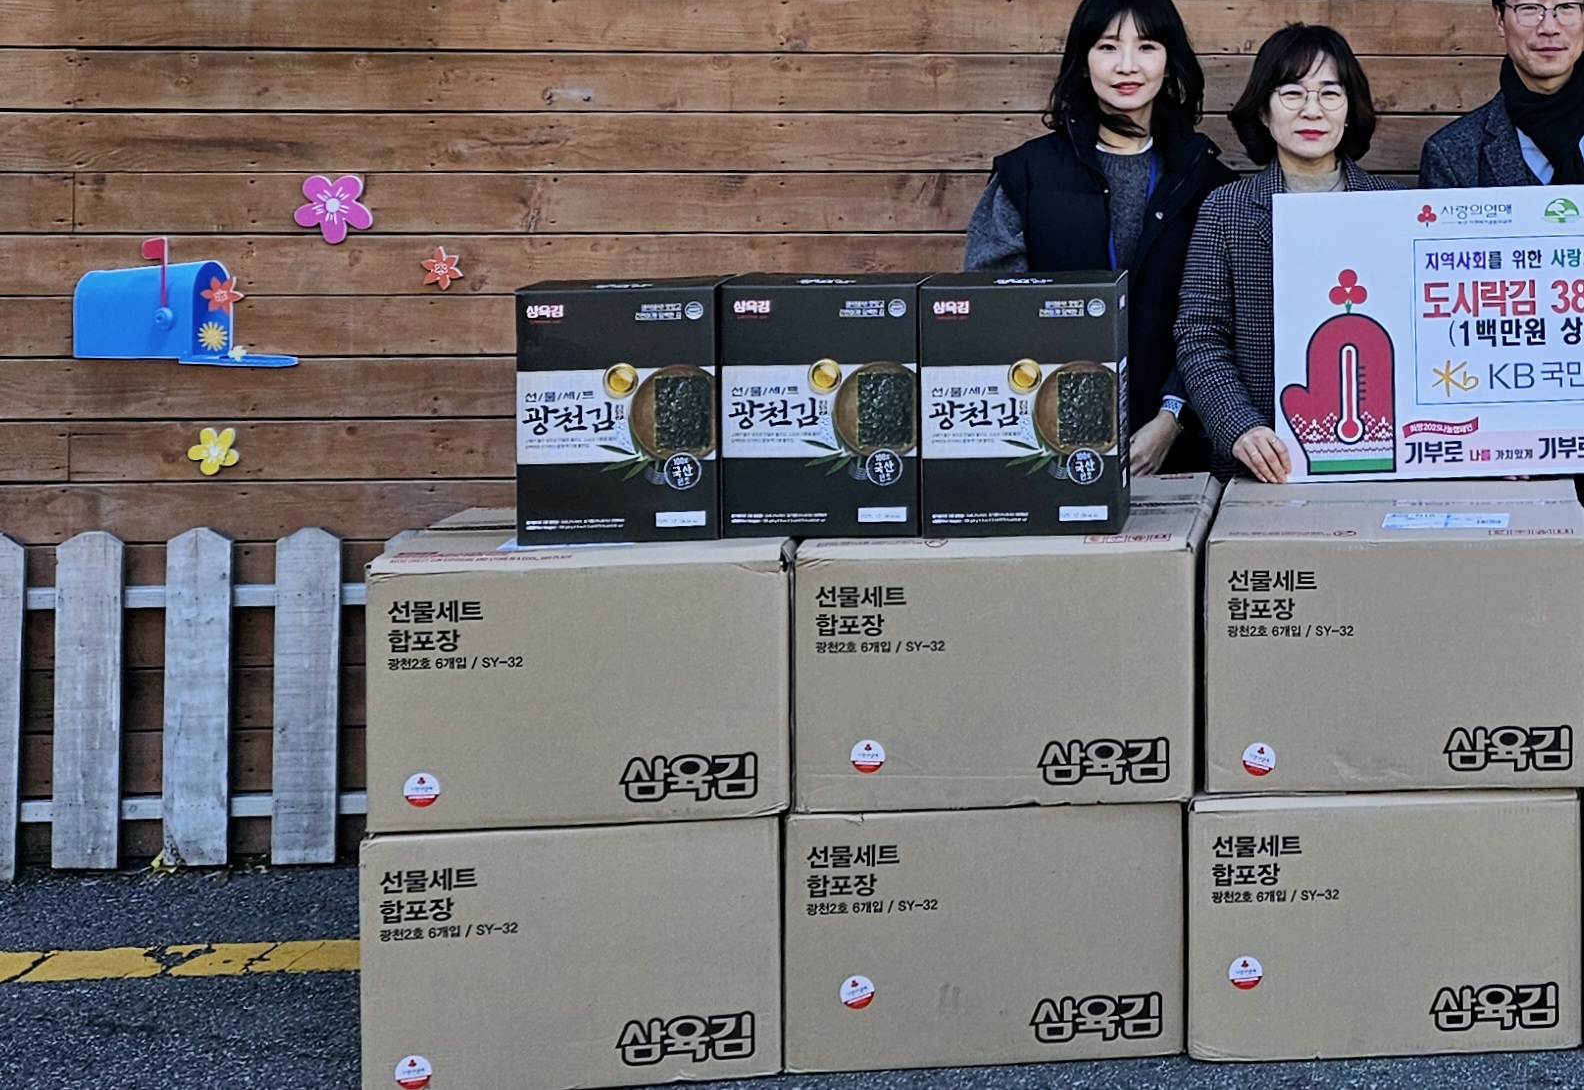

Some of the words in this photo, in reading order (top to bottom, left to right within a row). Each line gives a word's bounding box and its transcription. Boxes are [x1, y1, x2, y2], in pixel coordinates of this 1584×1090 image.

[1425, 251, 1502, 271] 지역사회를
[1512, 249, 1542, 269] 위한
[733, 299, 771, 314] 삼육김
[932, 299, 970, 315] 삼육김
[1423, 279, 1536, 318] 도시락김
[526, 304, 565, 319] 삼육김
[522, 401, 617, 434] 광천김
[728, 396, 819, 429] 광천김
[928, 397, 1020, 429] 광천김
[1405, 440, 1464, 464] 기부로
[1470, 449, 1491, 462] 나를
[1495, 449, 1533, 461] 가치있게
[1228, 570, 1317, 592] 선물세트
[816, 586, 906, 608] 선물세트
[388, 600, 483, 623] 선물세트
[1228, 598, 1295, 620] 합포장
[816, 614, 884, 636] 합포장
[1228, 625, 1268, 637] 광천2호
[1272, 625, 1301, 637] 6개입
[1316, 626, 1353, 636] SY-32
[388, 629, 460, 652] 합포장
[816, 642, 856, 653] 광천2호
[861, 641, 891, 652] 6개입
[906, 641, 945, 652] SY-32
[388, 658, 431, 670] 광천2호
[436, 657, 466, 669] 6개입
[482, 657, 523, 668] SY-32
[1443, 725, 1573, 772] 삼육김
[1037, 737, 1170, 785] 삼육김
[619, 752, 758, 802] 삼육김
[807, 844, 900, 868] 선물세트
[1212, 835, 1302, 858] 선물세트
[380, 868, 477, 894] 선물세트
[807, 874, 877, 898] 합포장
[1212, 863, 1280, 886] 합포장
[807, 902, 848, 916] 광천2호
[853, 901, 883, 913] 6개입
[898, 899, 938, 911] SY-32
[1212, 891, 1252, 903] 광천2호
[1256, 890, 1286, 902] 6개입
[1301, 889, 1339, 901] SY-32
[380, 897, 454, 924] 합포장
[380, 928, 424, 942] 광천2호
[429, 925, 460, 938] 6개입
[476, 922, 518, 935] SY-32
[1029, 991, 1162, 1043] 삼육김
[1429, 982, 1559, 1032] 삼육김
[615, 1011, 755, 1066] 삼육김
